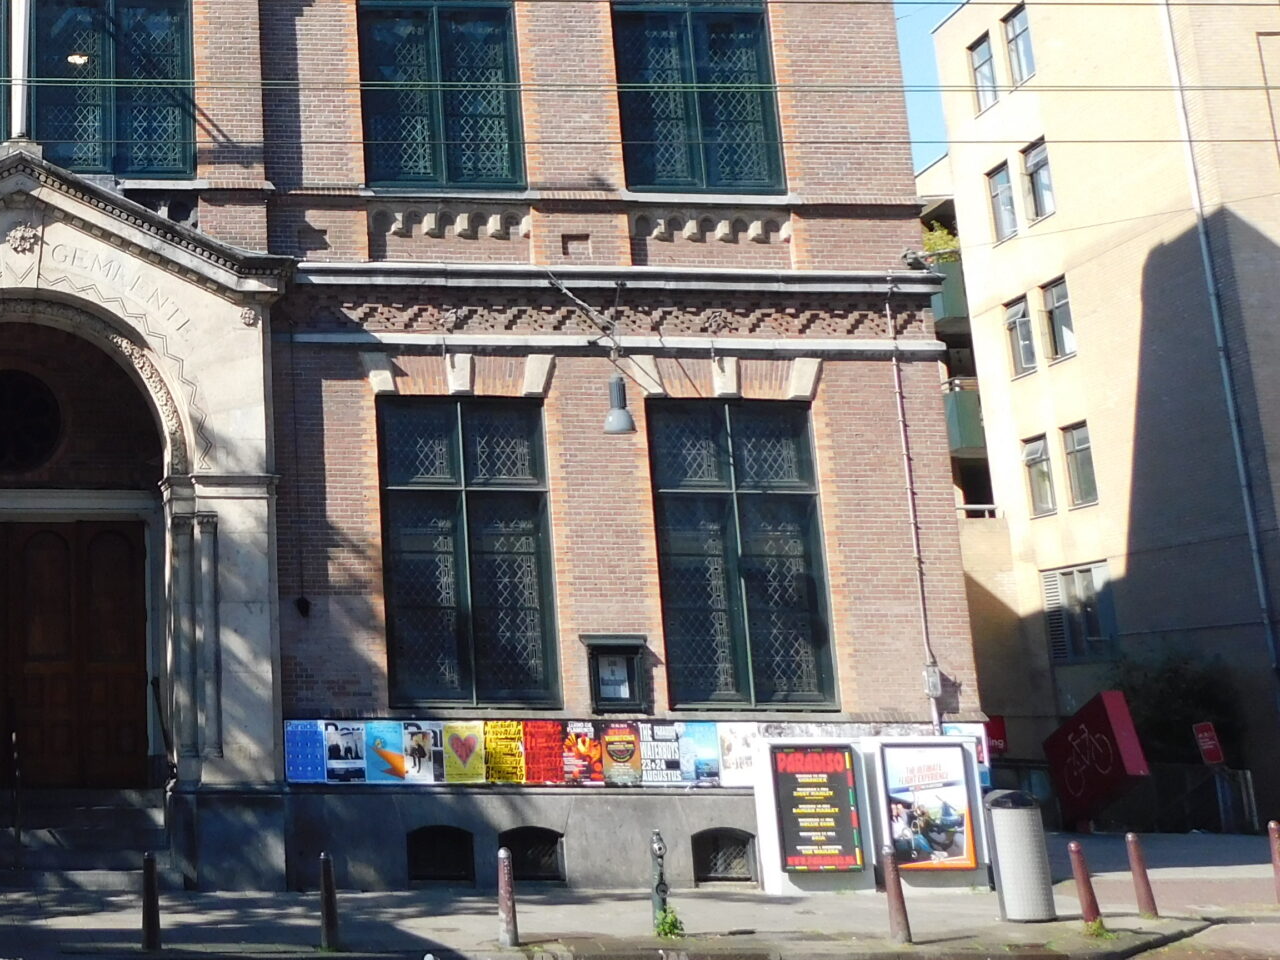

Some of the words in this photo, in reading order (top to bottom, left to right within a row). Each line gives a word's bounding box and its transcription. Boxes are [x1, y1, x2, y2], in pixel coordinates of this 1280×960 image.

[640, 723, 653, 741] THE
[640, 742, 679, 759] WATERBOYS
[776, 752, 844, 773] PARADISO
[642, 771, 682, 781] AUGUSTUS
